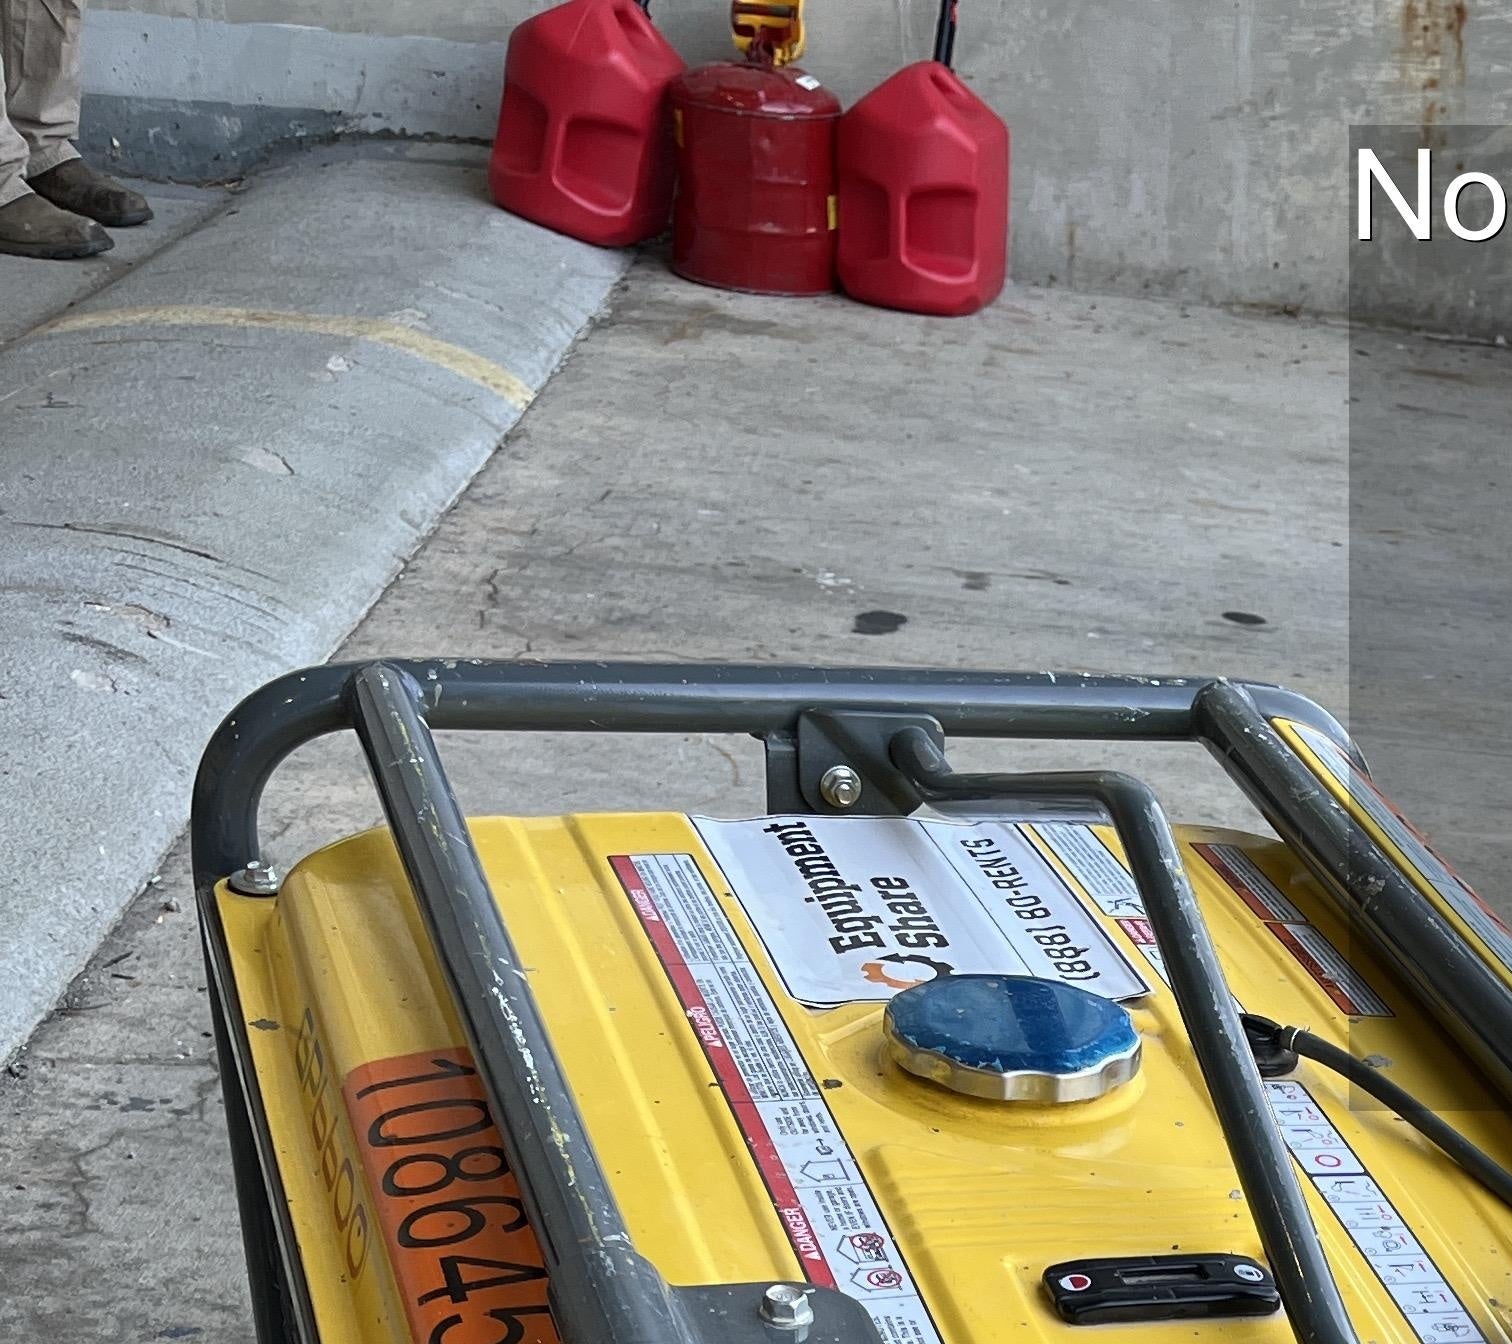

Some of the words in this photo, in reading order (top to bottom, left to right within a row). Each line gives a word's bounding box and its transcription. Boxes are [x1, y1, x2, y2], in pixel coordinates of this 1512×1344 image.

[763, 821, 887, 955] Equipment
[960, 838, 1052, 920] 80-RENTS
[869, 876, 950, 949] Share
[1025, 925, 1100, 980] (888)
[690, 1006, 719, 1041] PELIGRO
[783, 1207, 816, 1251] DANGER
